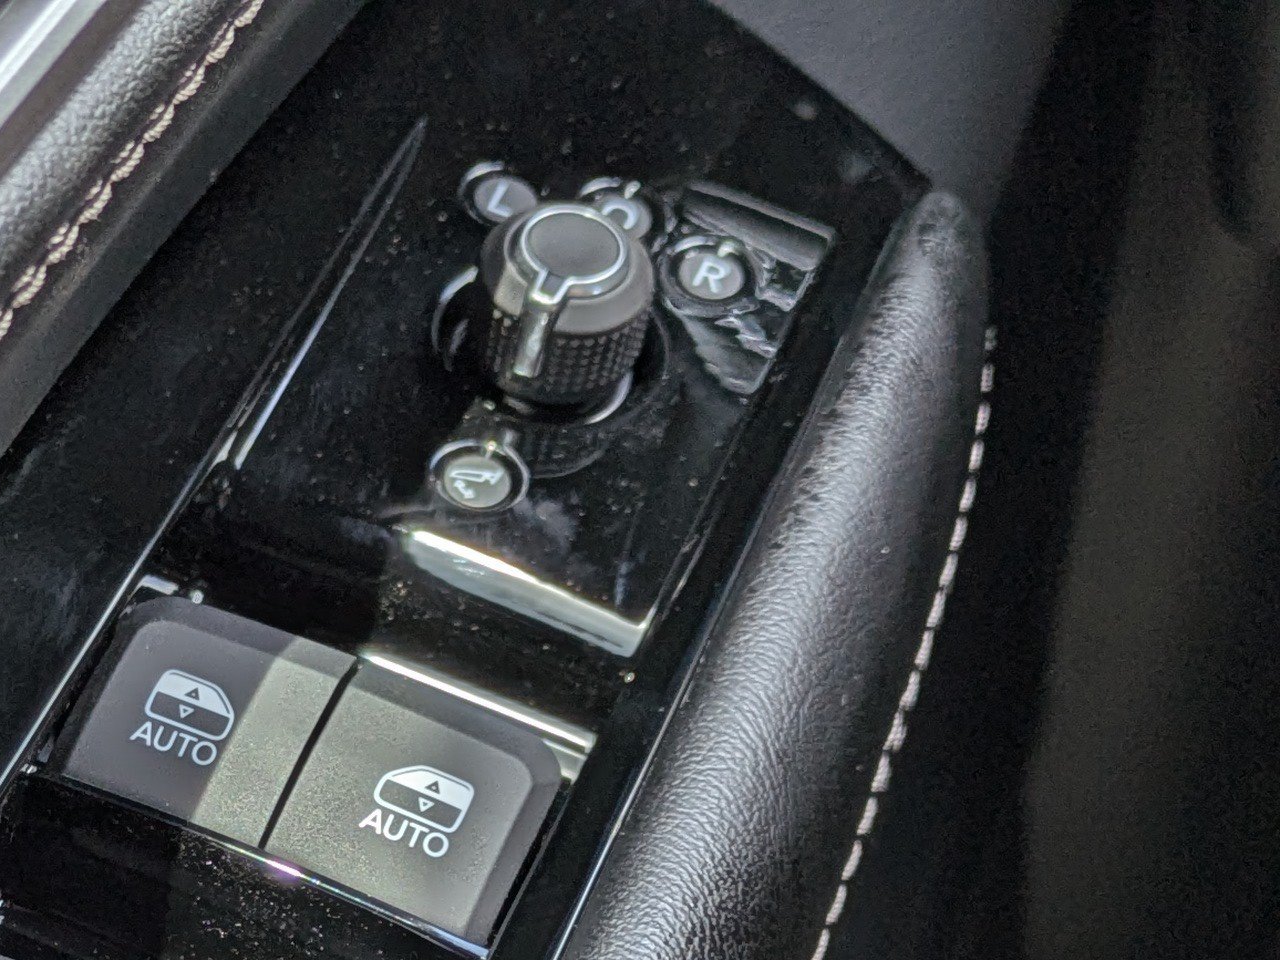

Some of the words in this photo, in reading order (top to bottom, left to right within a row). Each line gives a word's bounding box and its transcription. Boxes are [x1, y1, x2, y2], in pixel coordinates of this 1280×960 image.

[488, 181, 512, 217] L
[691, 260, 729, 293] R
[129, 721, 218, 766] AUTO
[358, 807, 450, 858] AUTO
